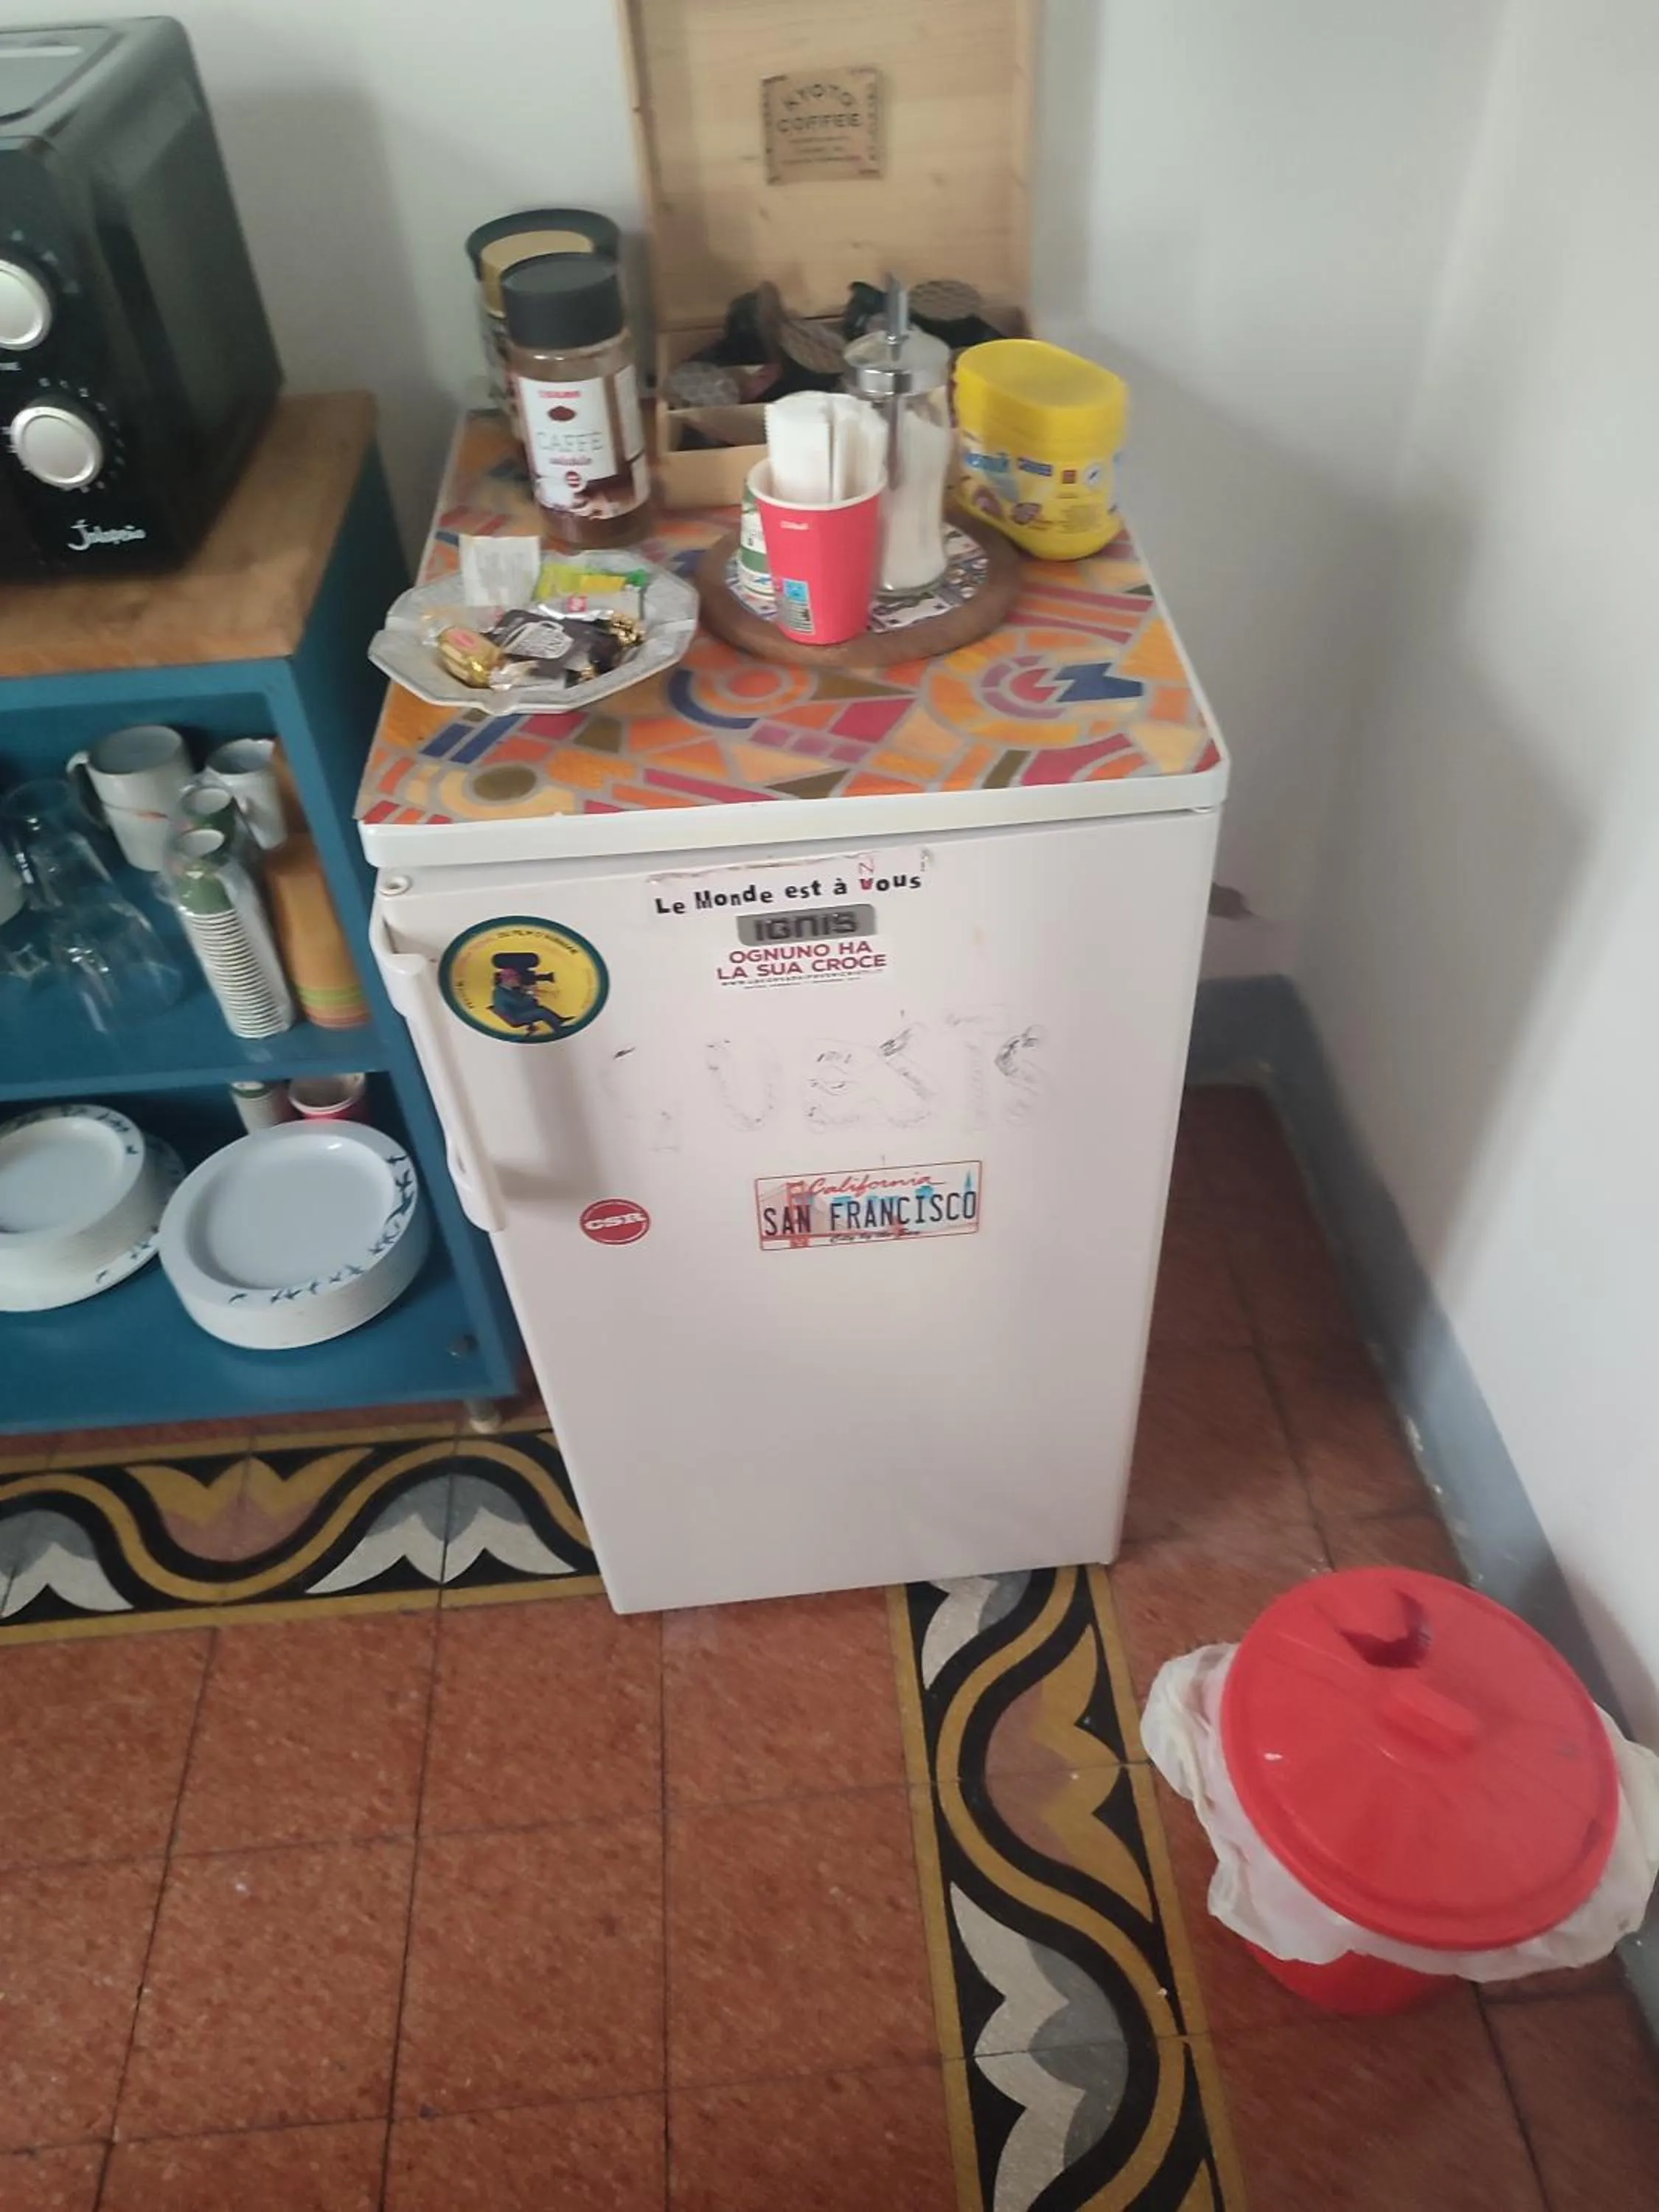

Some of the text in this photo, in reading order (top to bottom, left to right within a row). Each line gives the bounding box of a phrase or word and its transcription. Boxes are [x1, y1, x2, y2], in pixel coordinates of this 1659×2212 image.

[778, 113, 861, 133] COFFEE
[655, 898, 686, 914] Le
[695, 885, 773, 909] Monde
[785, 880, 821, 898] est
[833, 877, 847, 895] à
[755, 911, 857, 942] IGNIS
[729, 941, 872, 963] OGNUNO HA
[717, 967, 748, 979] LA
[757, 961, 802, 976] SUA
[812, 954, 887, 972] CROCE
[808, 1172, 946, 1197] California
[763, 1205, 811, 1236] SAN
[830, 1191, 976, 1232] FRANCISCO
